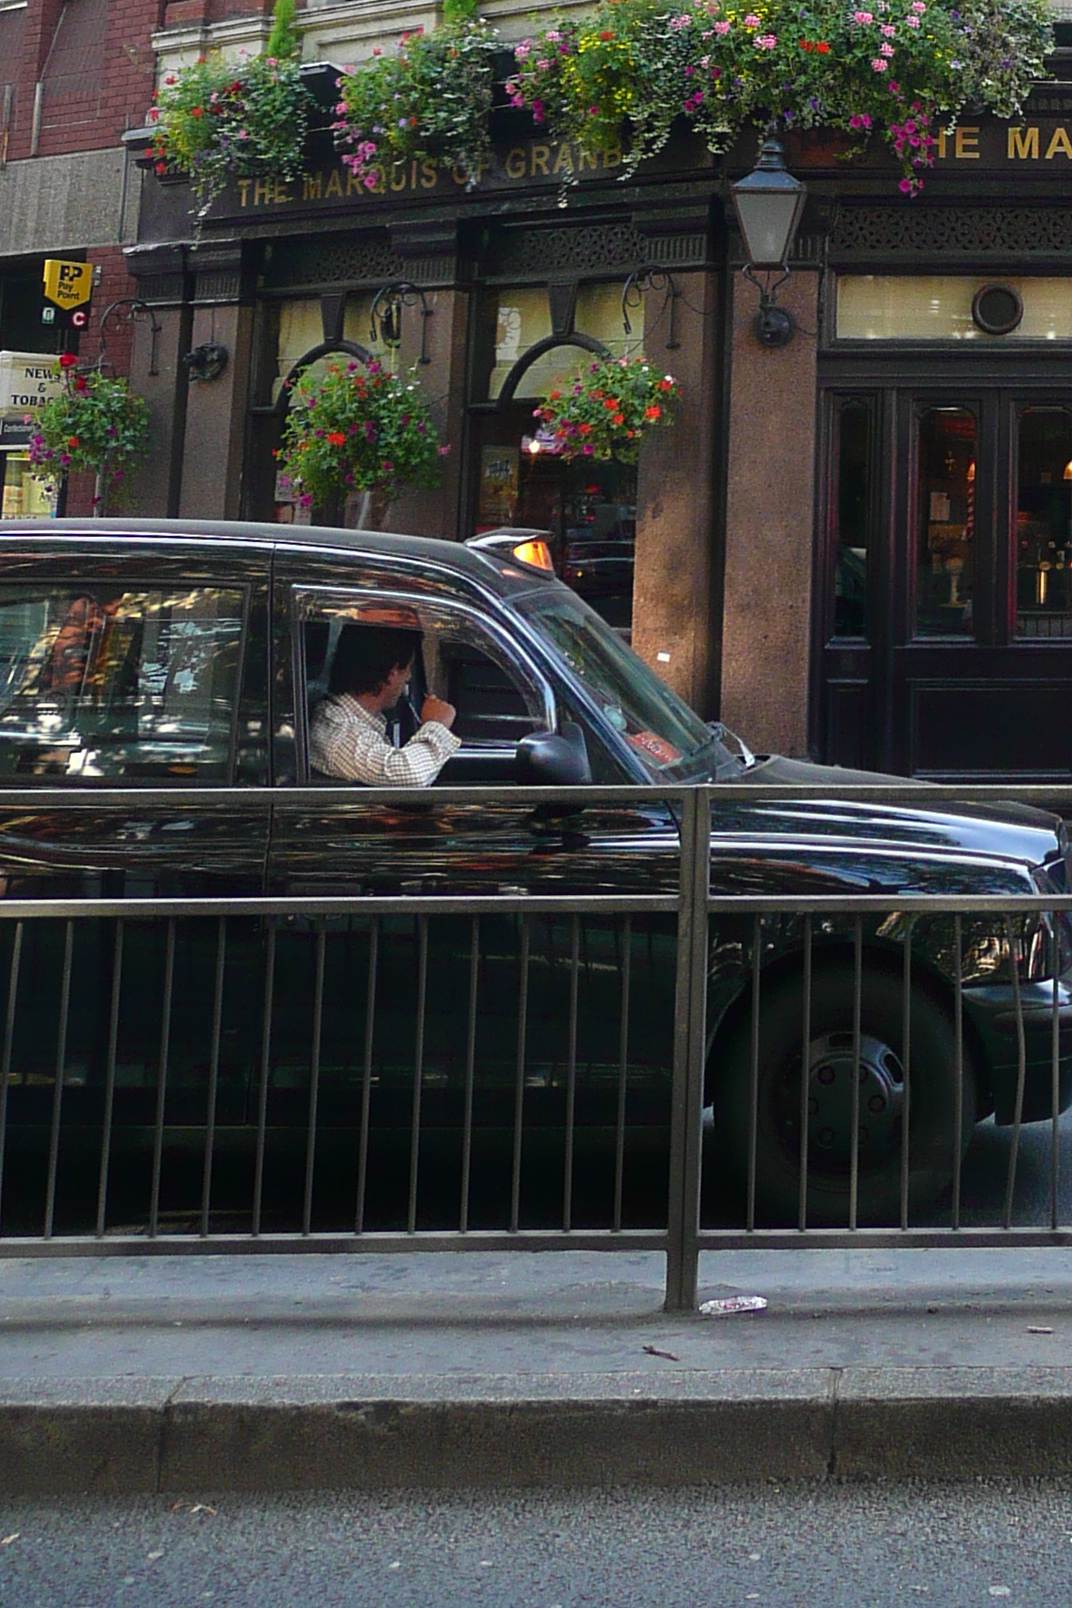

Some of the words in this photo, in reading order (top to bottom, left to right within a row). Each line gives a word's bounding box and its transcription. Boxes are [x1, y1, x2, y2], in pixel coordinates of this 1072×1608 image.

[931, 126, 980, 159] HE
[236, 177, 288, 208] THE
[505, 139, 622, 179] GRANB
[58, 281, 74, 292] Pay
[57, 290, 80, 301] Point
[25, 368, 61, 380] NEWS
[37, 382, 47, 393] &
